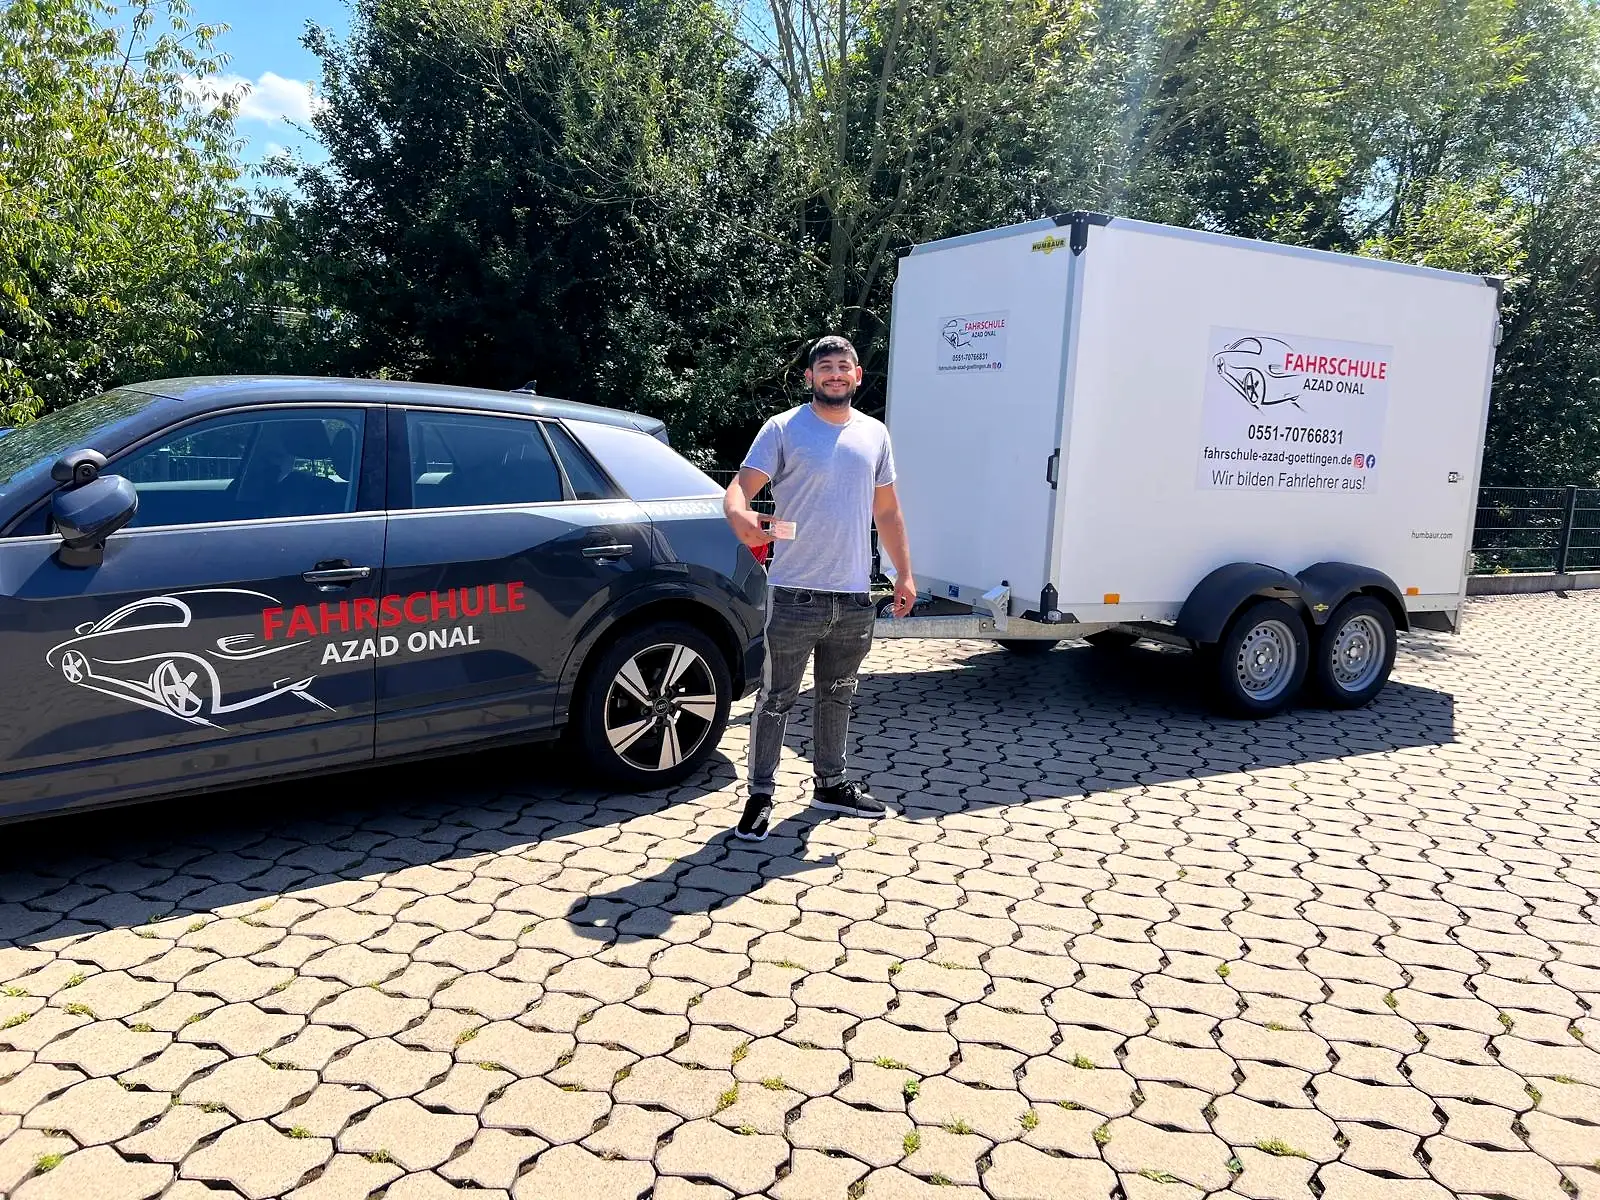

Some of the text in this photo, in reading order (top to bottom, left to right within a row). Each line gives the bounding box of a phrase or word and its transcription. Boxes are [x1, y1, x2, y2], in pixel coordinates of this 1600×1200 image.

[1031, 239, 1065, 251] HUMBAUR
[964, 319, 1005, 331] FAHRSCHULE
[1284, 353, 1387, 380] FAHRSCHULE
[1303, 378, 1365, 395] AZAD ONAL
[1247, 424, 1344, 444] 0551-70766831
[1203, 446, 1353, 467] fahrschule-azad-goettingen.de
[1211, 470, 1367, 490] Wir bilden Fahrlehrer aus!
[1411, 530, 1453, 540] humbaur.com
[262, 581, 526, 641] FAHRSCHULE
[320, 625, 481, 665] AZAD ONAL
